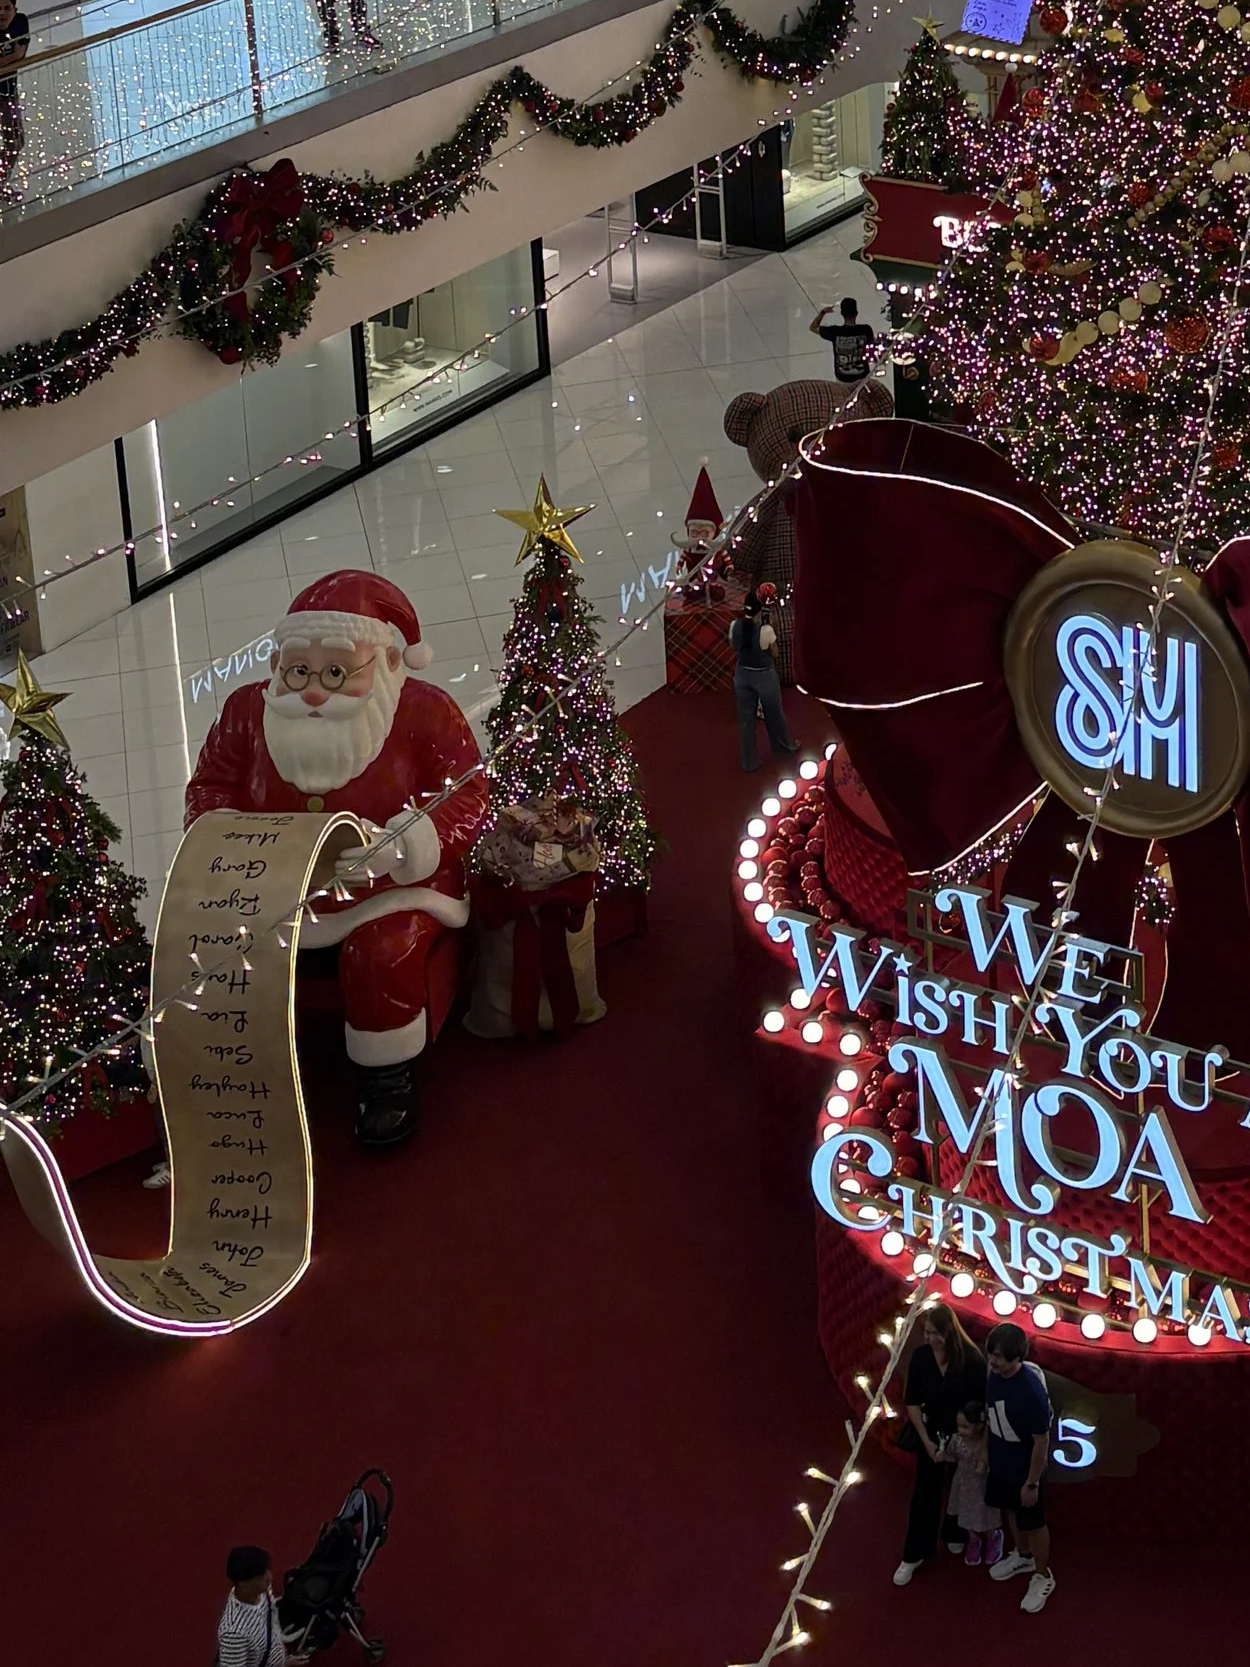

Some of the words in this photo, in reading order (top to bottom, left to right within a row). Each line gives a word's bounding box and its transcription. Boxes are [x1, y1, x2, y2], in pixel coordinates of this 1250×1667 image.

[1056, 615, 1198, 793] SM
[208, 857, 267, 879] Gary
[198, 888, 261, 916] Ryan
[935, 887, 1110, 1004] WE
[200, 1010, 248, 1033] Lia
[204, 1044, 253, 1065] Sebi
[1037, 1002, 1228, 1112] YOU
[189, 1074, 271, 1100] Hayley
[207, 1110, 264, 1129] Luca
[888, 1038, 1211, 1225] MOA
[208, 1134, 268, 1156] Hugo
[211, 1170, 272, 1195] Cooper
[207, 1198, 272, 1230] Henry
[212, 1240, 264, 1267] John
[200, 1262, 247, 1299] James
